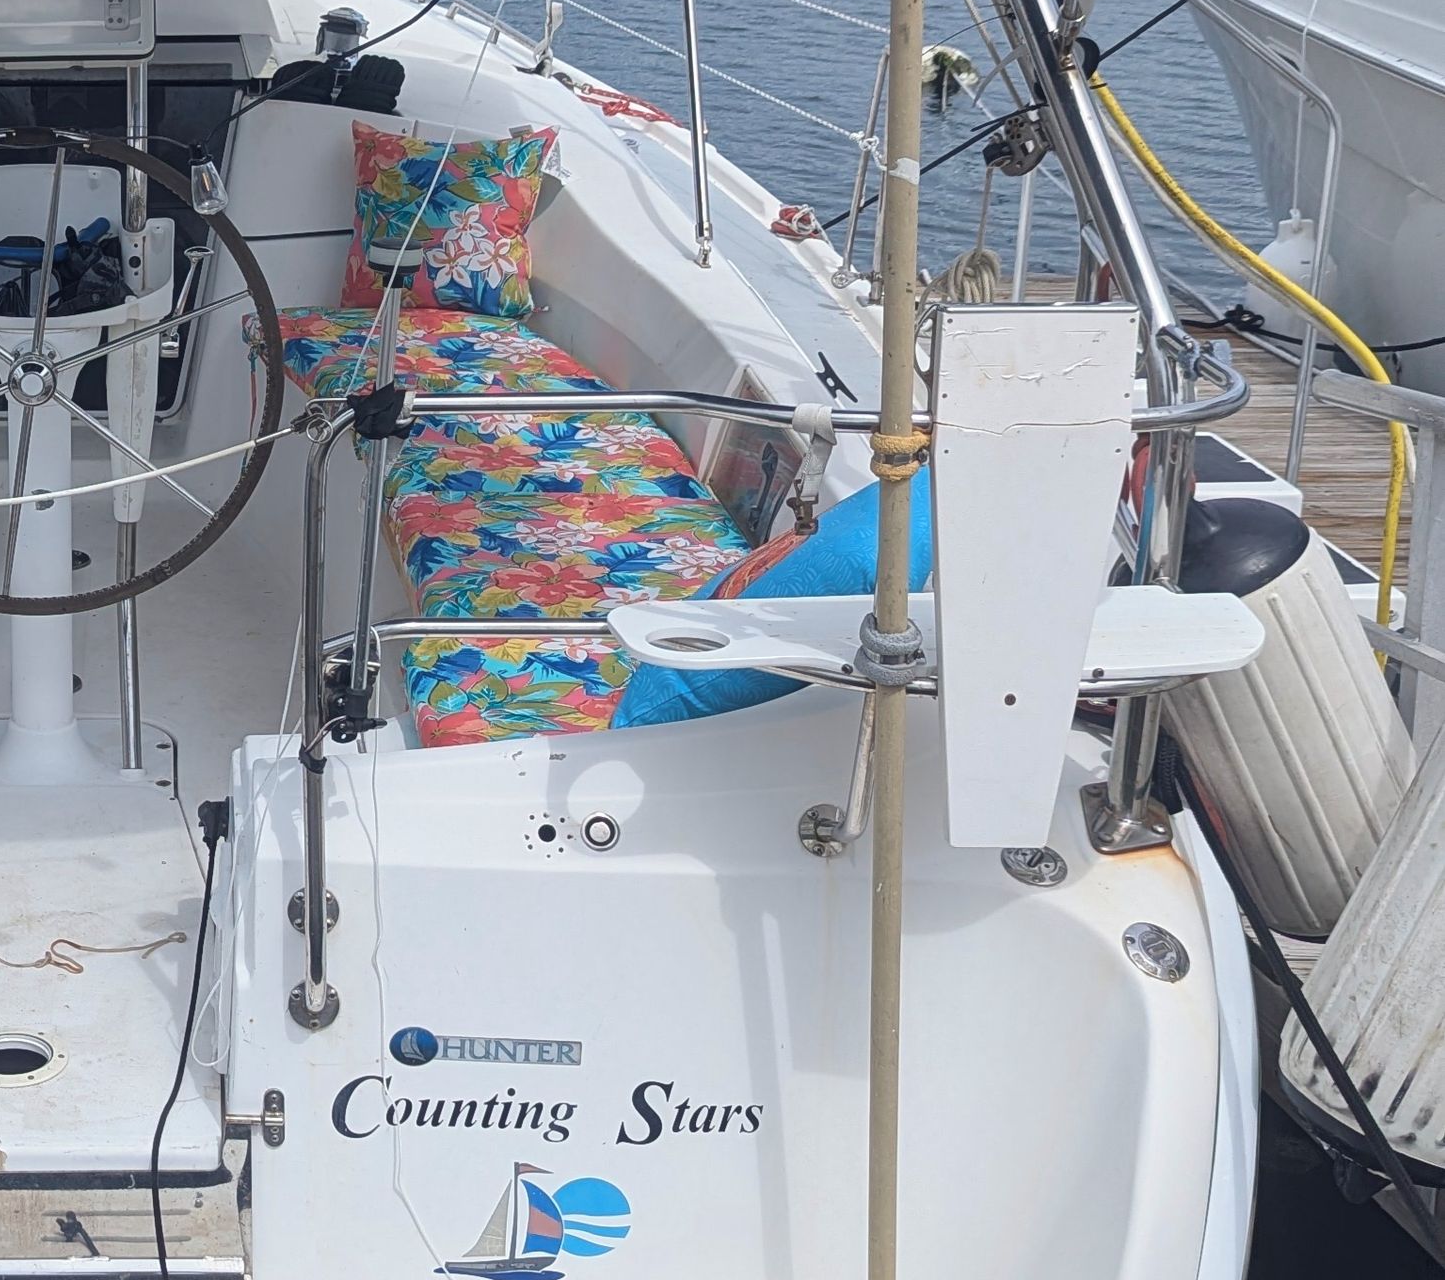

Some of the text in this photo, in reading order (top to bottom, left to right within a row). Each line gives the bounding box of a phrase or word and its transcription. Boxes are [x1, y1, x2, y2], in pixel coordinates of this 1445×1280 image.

[441, 1037, 579, 1065] HUNTER
[331, 1075, 765, 1146] Counting Stars
